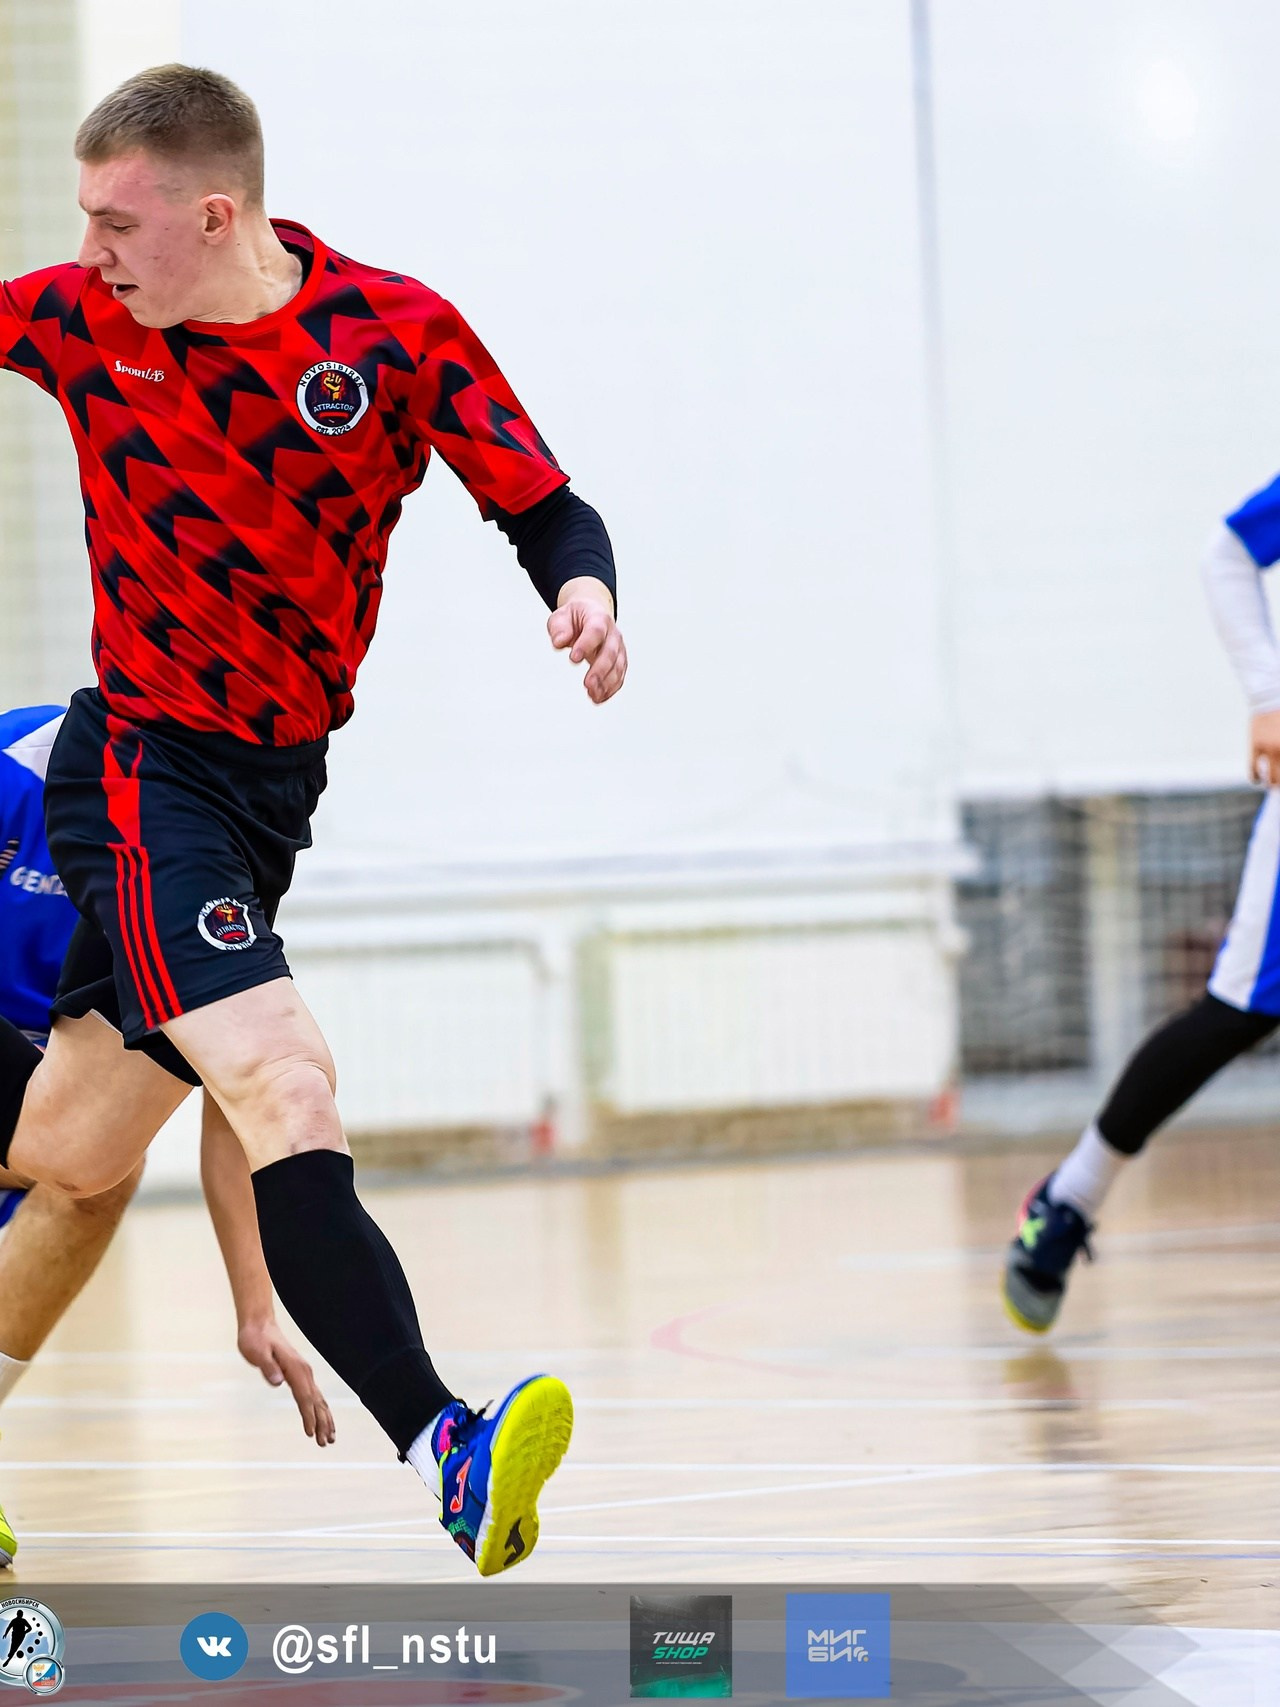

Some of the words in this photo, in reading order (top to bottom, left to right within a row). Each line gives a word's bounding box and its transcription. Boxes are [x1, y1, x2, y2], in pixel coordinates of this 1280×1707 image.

[300, 363, 365, 388] NOVOSIBIRSK
[313, 402, 355, 414] ATTRACTOR
[215, 923, 246, 938] ATTRACTOR
